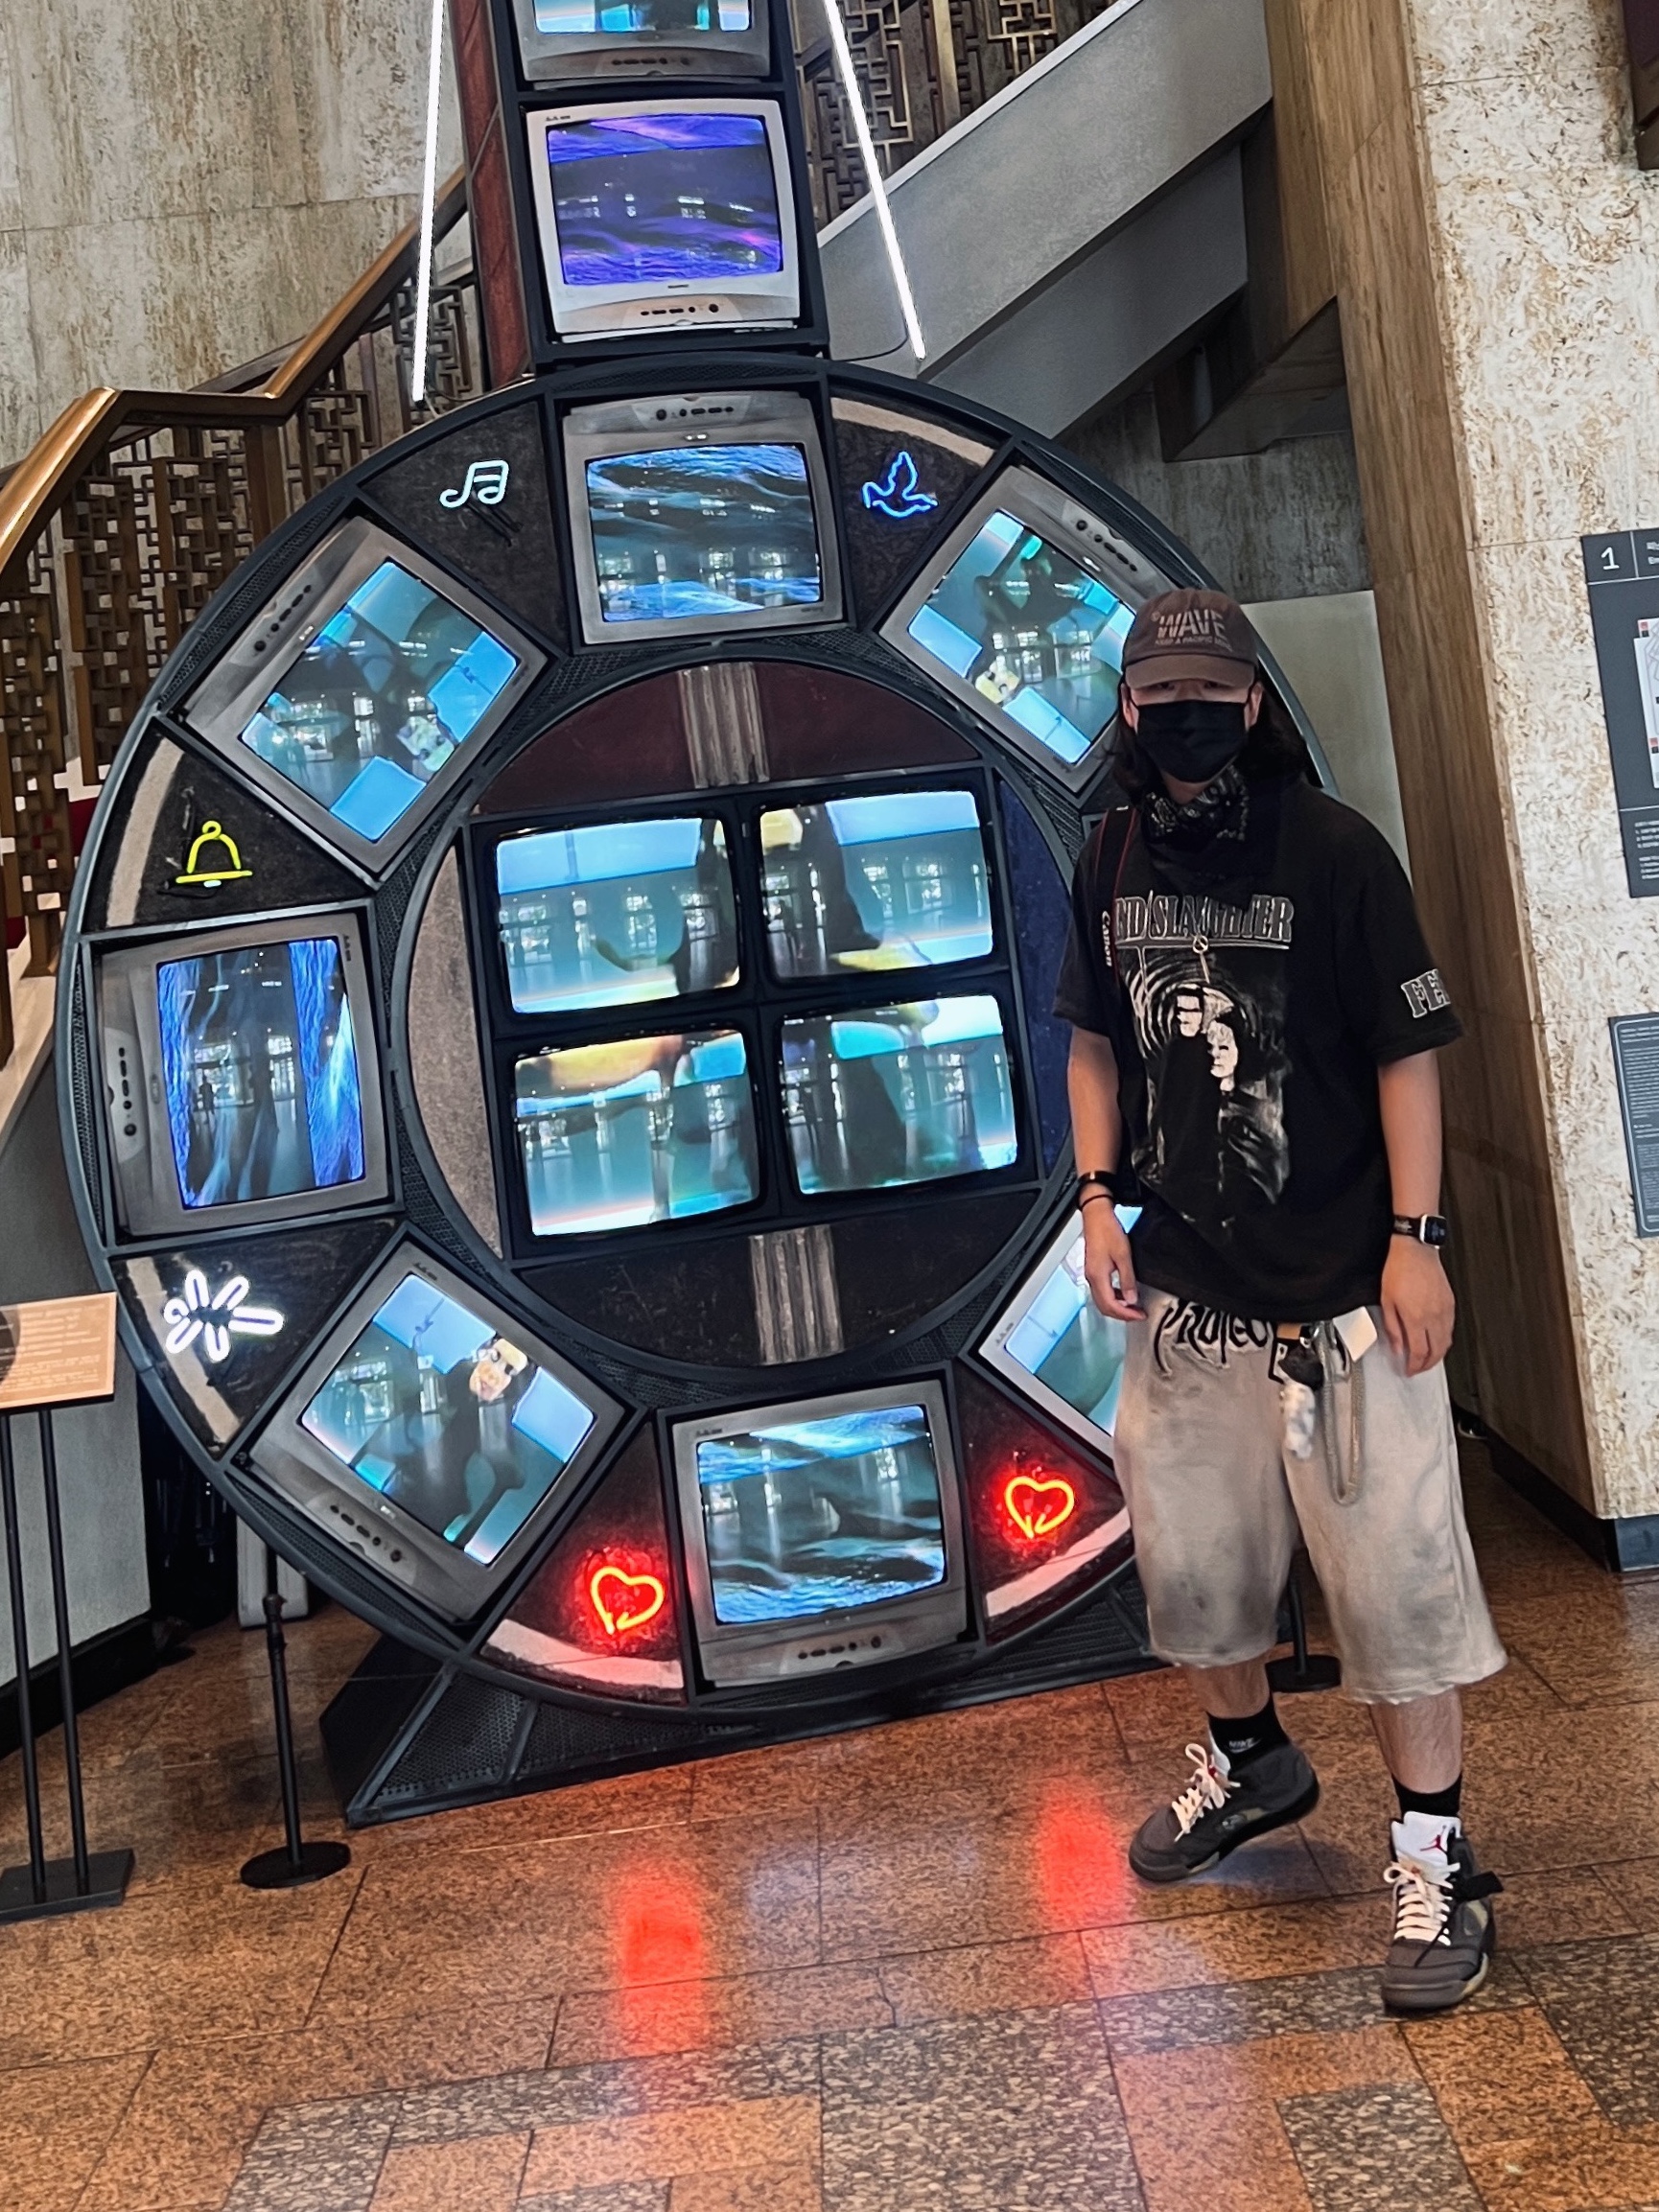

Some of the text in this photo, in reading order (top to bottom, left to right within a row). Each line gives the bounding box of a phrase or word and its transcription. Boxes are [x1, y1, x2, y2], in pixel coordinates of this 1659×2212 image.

[1601, 547, 1620, 570] 1
[1157, 609, 1227, 640] WAVE
[1102, 911, 1112, 967] Canon
[1228, 1736, 1254, 1748] NIKE
